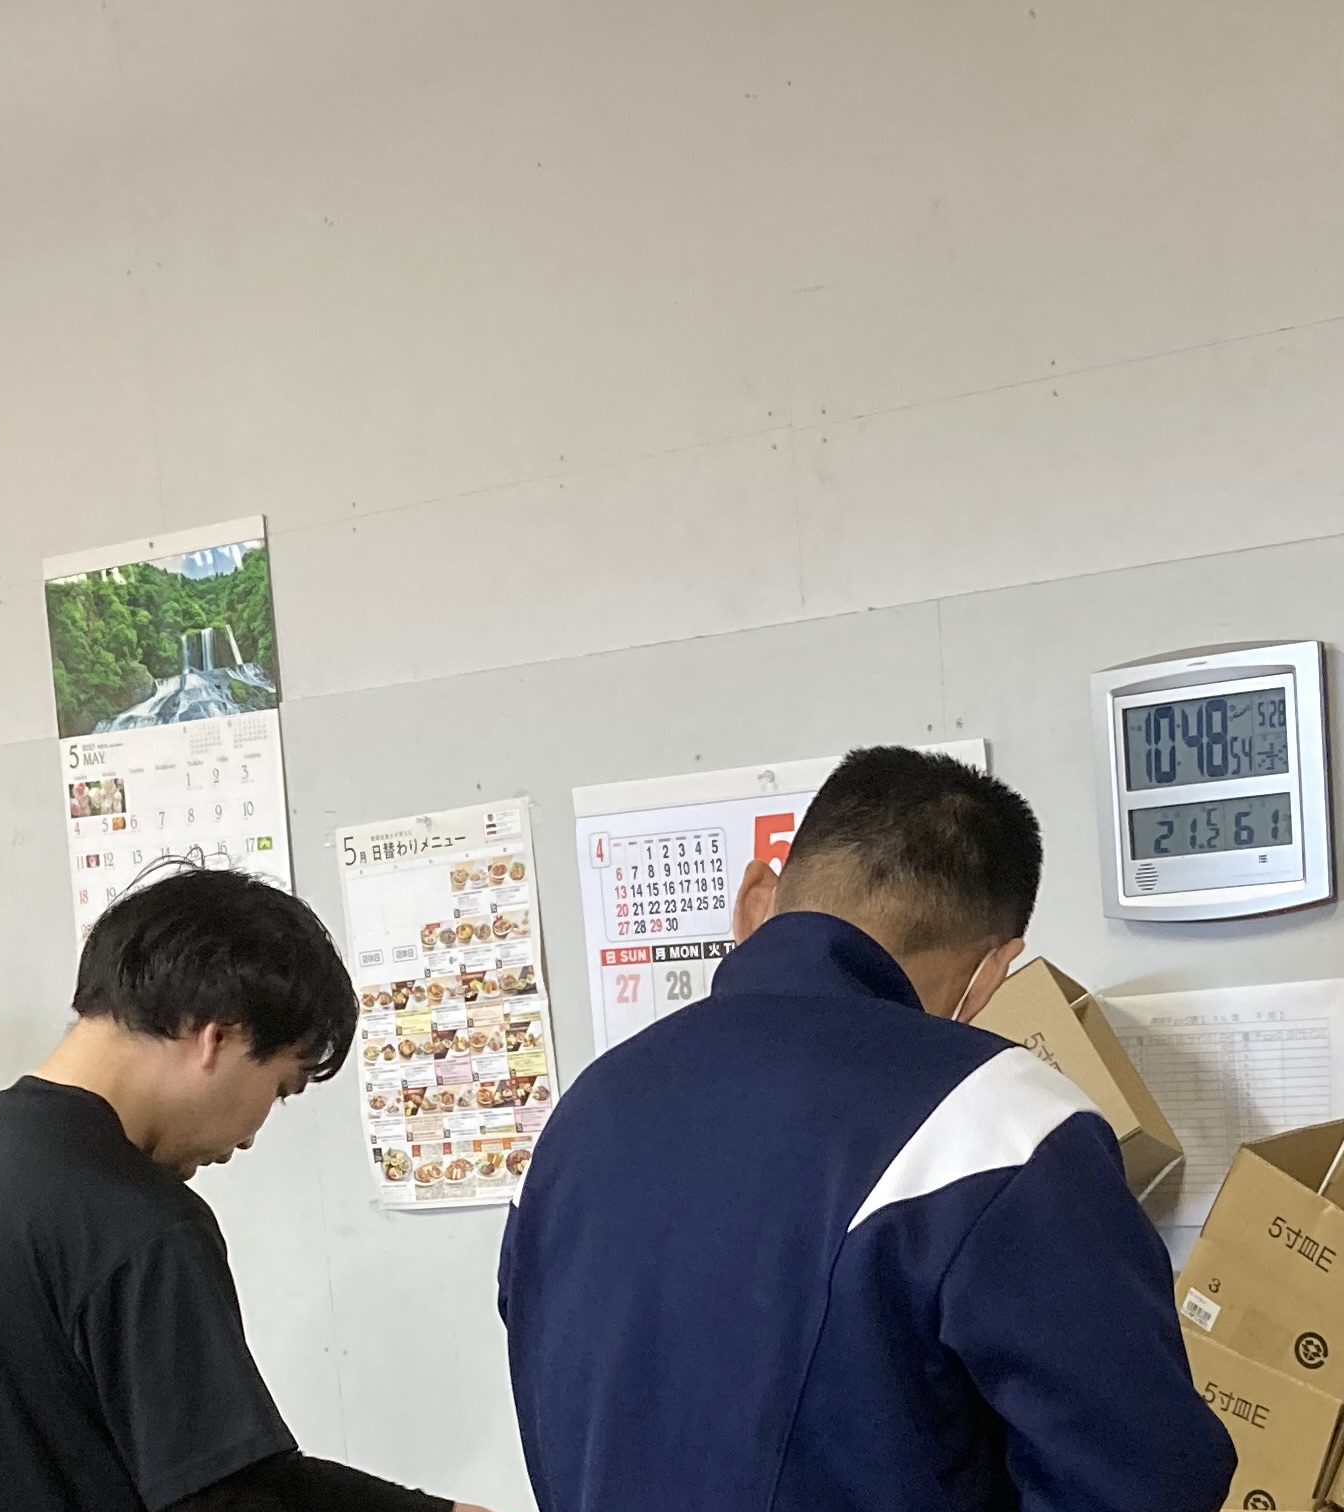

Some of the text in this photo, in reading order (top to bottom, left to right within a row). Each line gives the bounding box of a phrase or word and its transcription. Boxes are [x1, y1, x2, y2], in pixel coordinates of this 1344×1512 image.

[1145, 699, 1253, 784] 10:48 54
[69, 744, 79, 769] 5
[83, 751, 105, 767] MAY
[186, 772, 191, 787] 1
[213, 768, 219, 783] 2
[242, 765, 248, 780] 3
[74, 801, 254, 835] 4 5 6 7 8 9 10
[1154, 809, 1280, 854] 21.2 61
[103, 852, 114, 867] 12
[133, 850, 142, 864] 13
[246, 838, 255, 852] 17
[344, 836, 466, 866] 5月 日替わりメニュー
[596, 838, 604, 862] 4
[647, 840, 718, 860] 1 2 3 4 5
[616, 858, 722, 881] 6 7 8 9 10 11 12
[79, 890, 88, 904] 18
[615, 877, 724, 899] 13 14 15 16 17 18 19
[616, 895, 725, 917] 20 21 22 23 24 25 26
[618, 917, 678, 935] 27 28 29 30
[606, 951, 616, 964] 日
[620, 949, 647, 962] SUN
[655, 947, 666, 960] 月
[669, 945, 699, 958] MON
[709, 943, 721, 957] 火
[616, 970, 692, 1004] 27 28
[1268, 1215, 1337, 1274] 5寸皿E
[1208, 1278, 1221, 1293] 3
